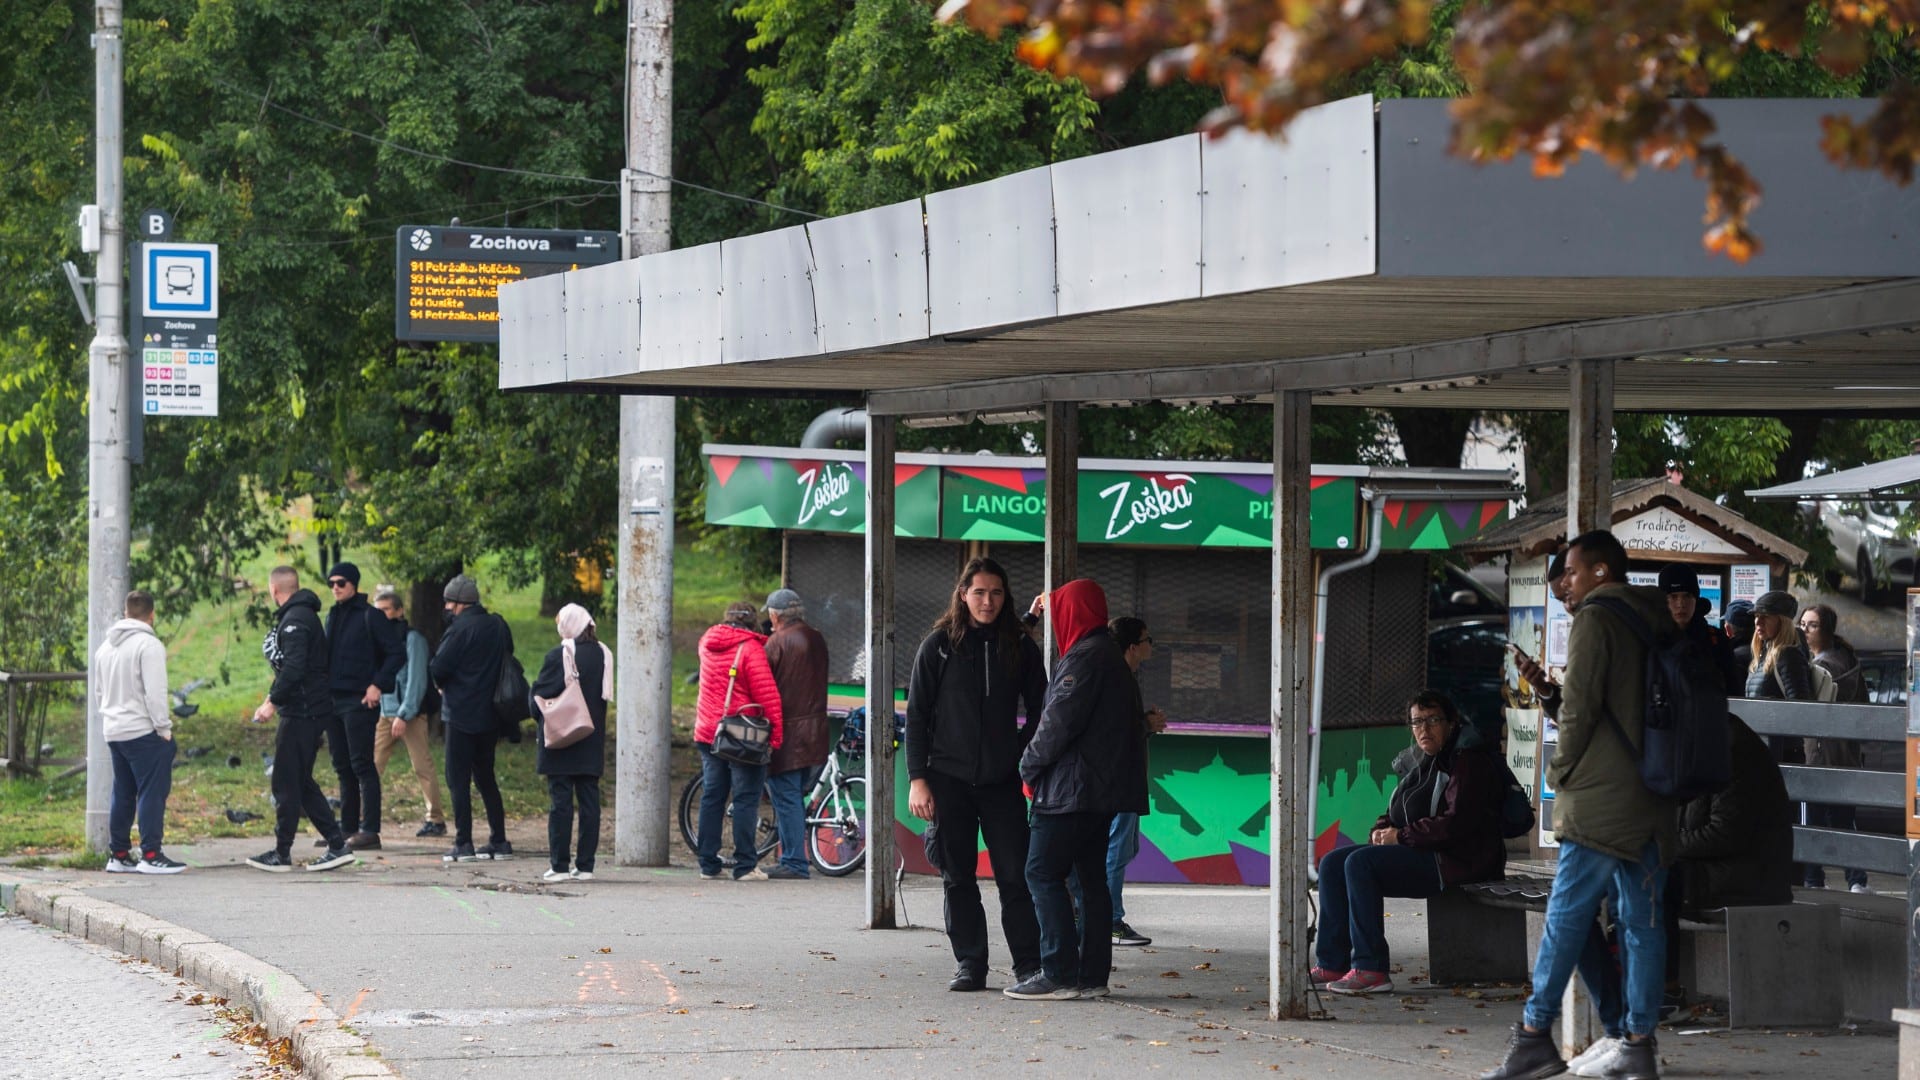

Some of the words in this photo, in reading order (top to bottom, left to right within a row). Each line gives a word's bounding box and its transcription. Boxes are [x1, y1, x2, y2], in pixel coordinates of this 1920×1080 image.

[149, 215, 165, 235] B
[469, 234, 550, 251] Zochova
[164, 321, 196, 330] Zochova
[797, 464, 850, 525] Zoška
[1100, 477, 1193, 540] Zoška
